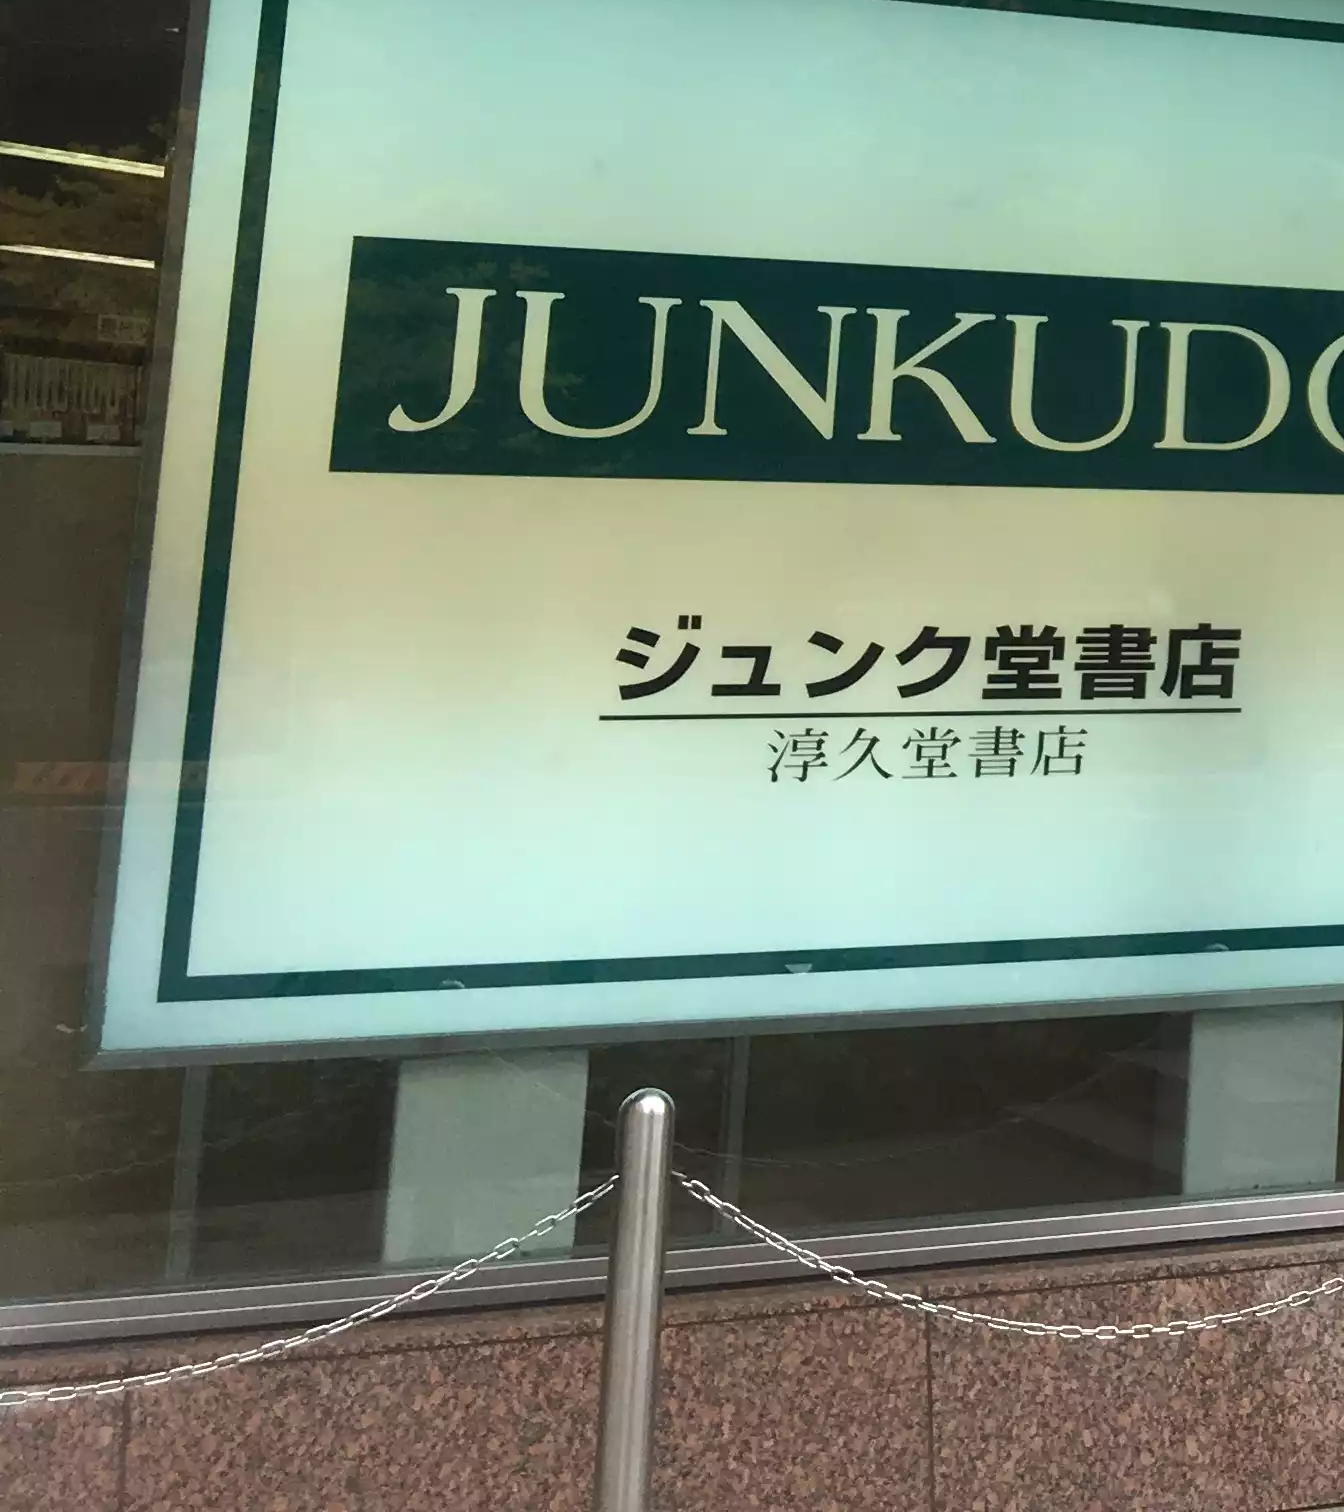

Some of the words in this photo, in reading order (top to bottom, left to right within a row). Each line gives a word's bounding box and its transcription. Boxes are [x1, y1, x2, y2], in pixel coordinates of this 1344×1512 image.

[615, 614, 1243, 702] ジュンク堂書店
[766, 725, 1089, 784] 淳久堂書店
